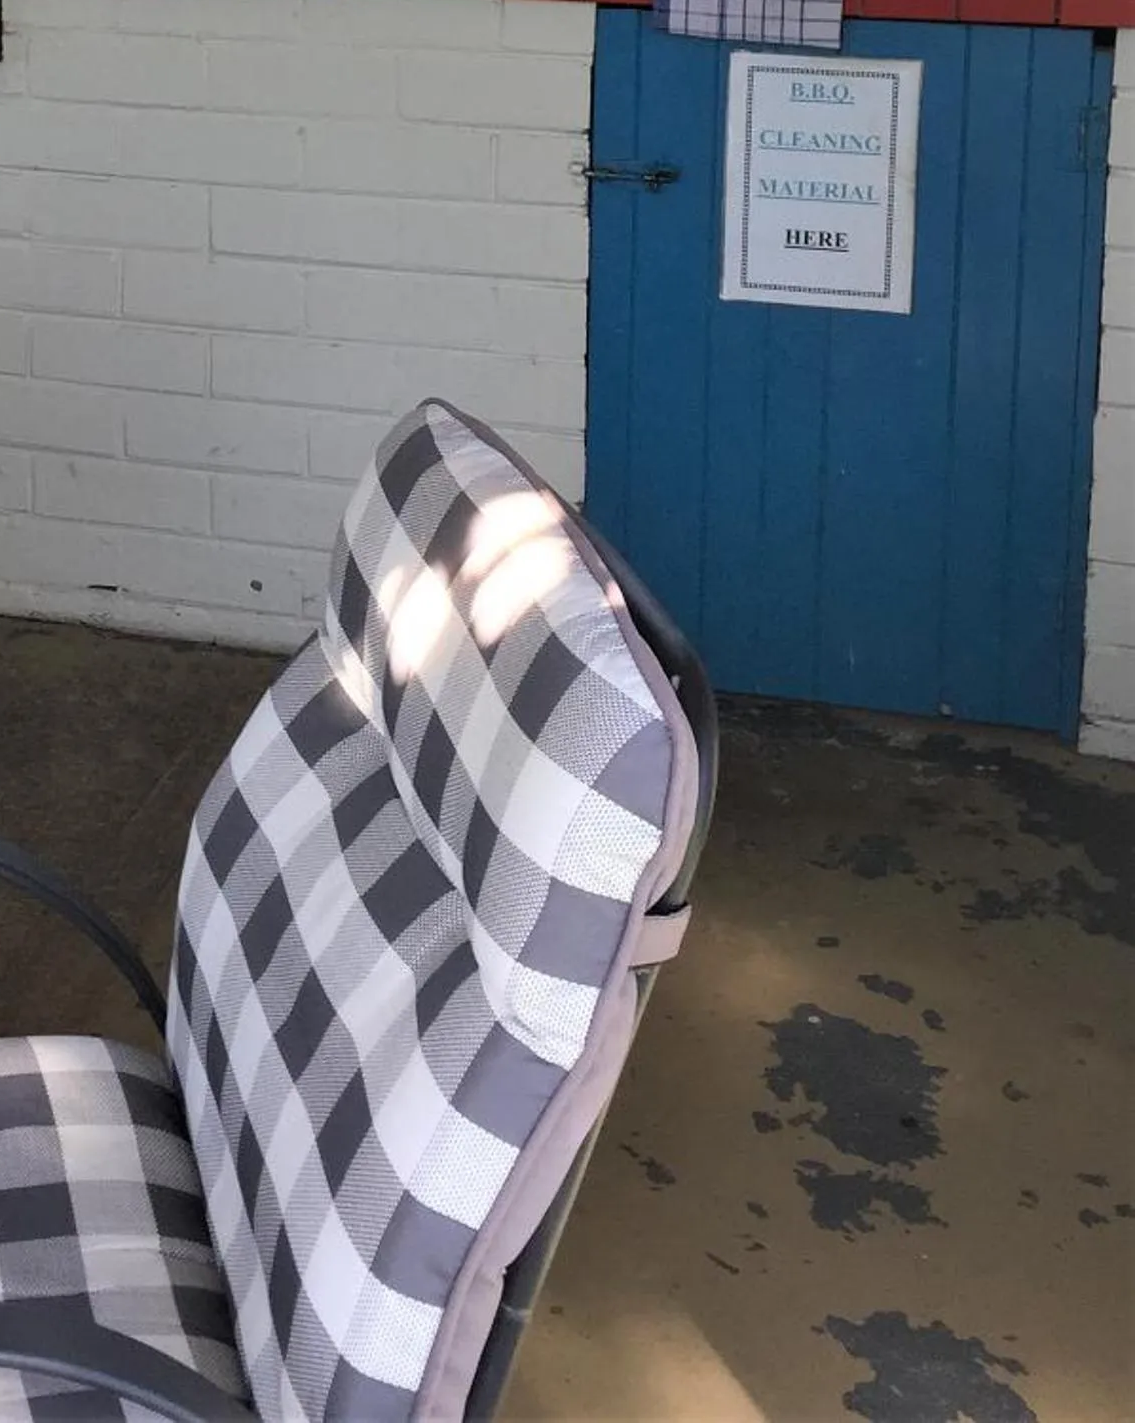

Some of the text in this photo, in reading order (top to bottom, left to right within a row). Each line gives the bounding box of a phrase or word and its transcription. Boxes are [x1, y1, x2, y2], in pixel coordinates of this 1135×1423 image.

[791, 82, 855, 104] B.B.Q.
[760, 130, 881, 152] CLEANING
[759, 179, 876, 201] MATERIAL
[785, 228, 849, 248] HERE
